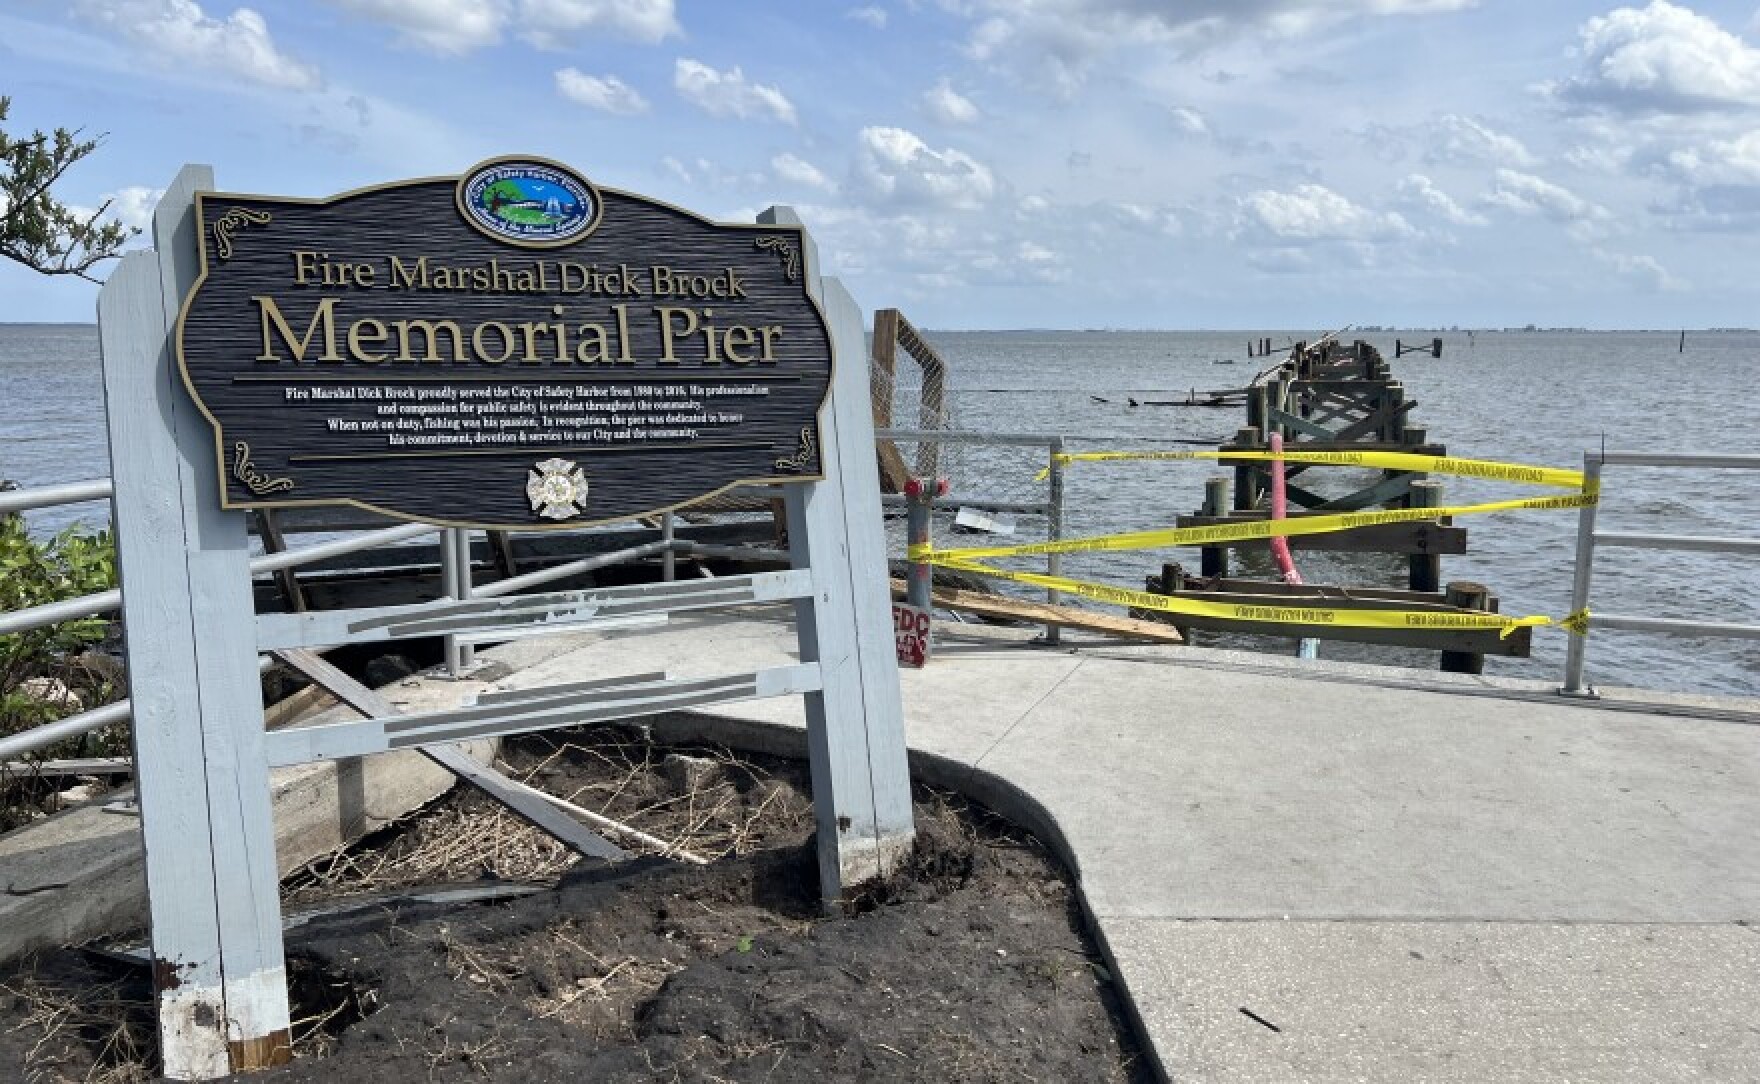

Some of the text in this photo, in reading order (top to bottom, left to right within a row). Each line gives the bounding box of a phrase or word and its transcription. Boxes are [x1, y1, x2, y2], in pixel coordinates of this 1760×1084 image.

[293, 251, 748, 298] Fire Marshal Dick Brock
[252, 295, 783, 363] Memorial Pier
[285, 387, 308, 399] Fire
[311, 387, 355, 399] Marshal
[357, 386, 383, 399] Dick
[385, 385, 415, 399] Brock
[417, 385, 457, 401] proudly
[459, 385, 491, 399] served
[493, 385, 511, 397] the
[512, 385, 532, 399] City
[545, 385, 573, 399] Safety
[575, 385, 609, 397] Harbor
[609, 385, 633, 397] from
[705, 383, 769, 397] professionalism
[377, 401, 397, 415] and
[399, 401, 459, 416] compassion
[459, 401, 475, 413] for
[477, 401, 507, 415] public
[509, 401, 537, 414] safety
[539, 399, 549, 411] is
[549, 400, 585, 411] evident
[585, 399, 637, 412] throughout
[637, 399, 653, 410] the
[327, 417, 359, 431] When
[361, 419, 379, 431] not
[381, 420, 395, 431] on
[396, 417, 423, 431] duty,
[423, 417, 461, 431] fishing
[461, 419, 481, 429] was
[483, 416, 499, 427] his
[611, 413, 627, 424] the
[627, 413, 645, 427] pier
[647, 414, 665, 424] was
[665, 411, 707, 423] dedicated
[389, 433, 405, 445] his
[473, 430, 517, 443] devotion
[519, 430, 527, 442] &
[529, 429, 563, 442] service
[563, 429, 575, 441] to
[575, 431, 591, 441] our
[593, 428, 613, 441] City
[613, 427, 631, 439] and
[631, 427, 647, 439] the
